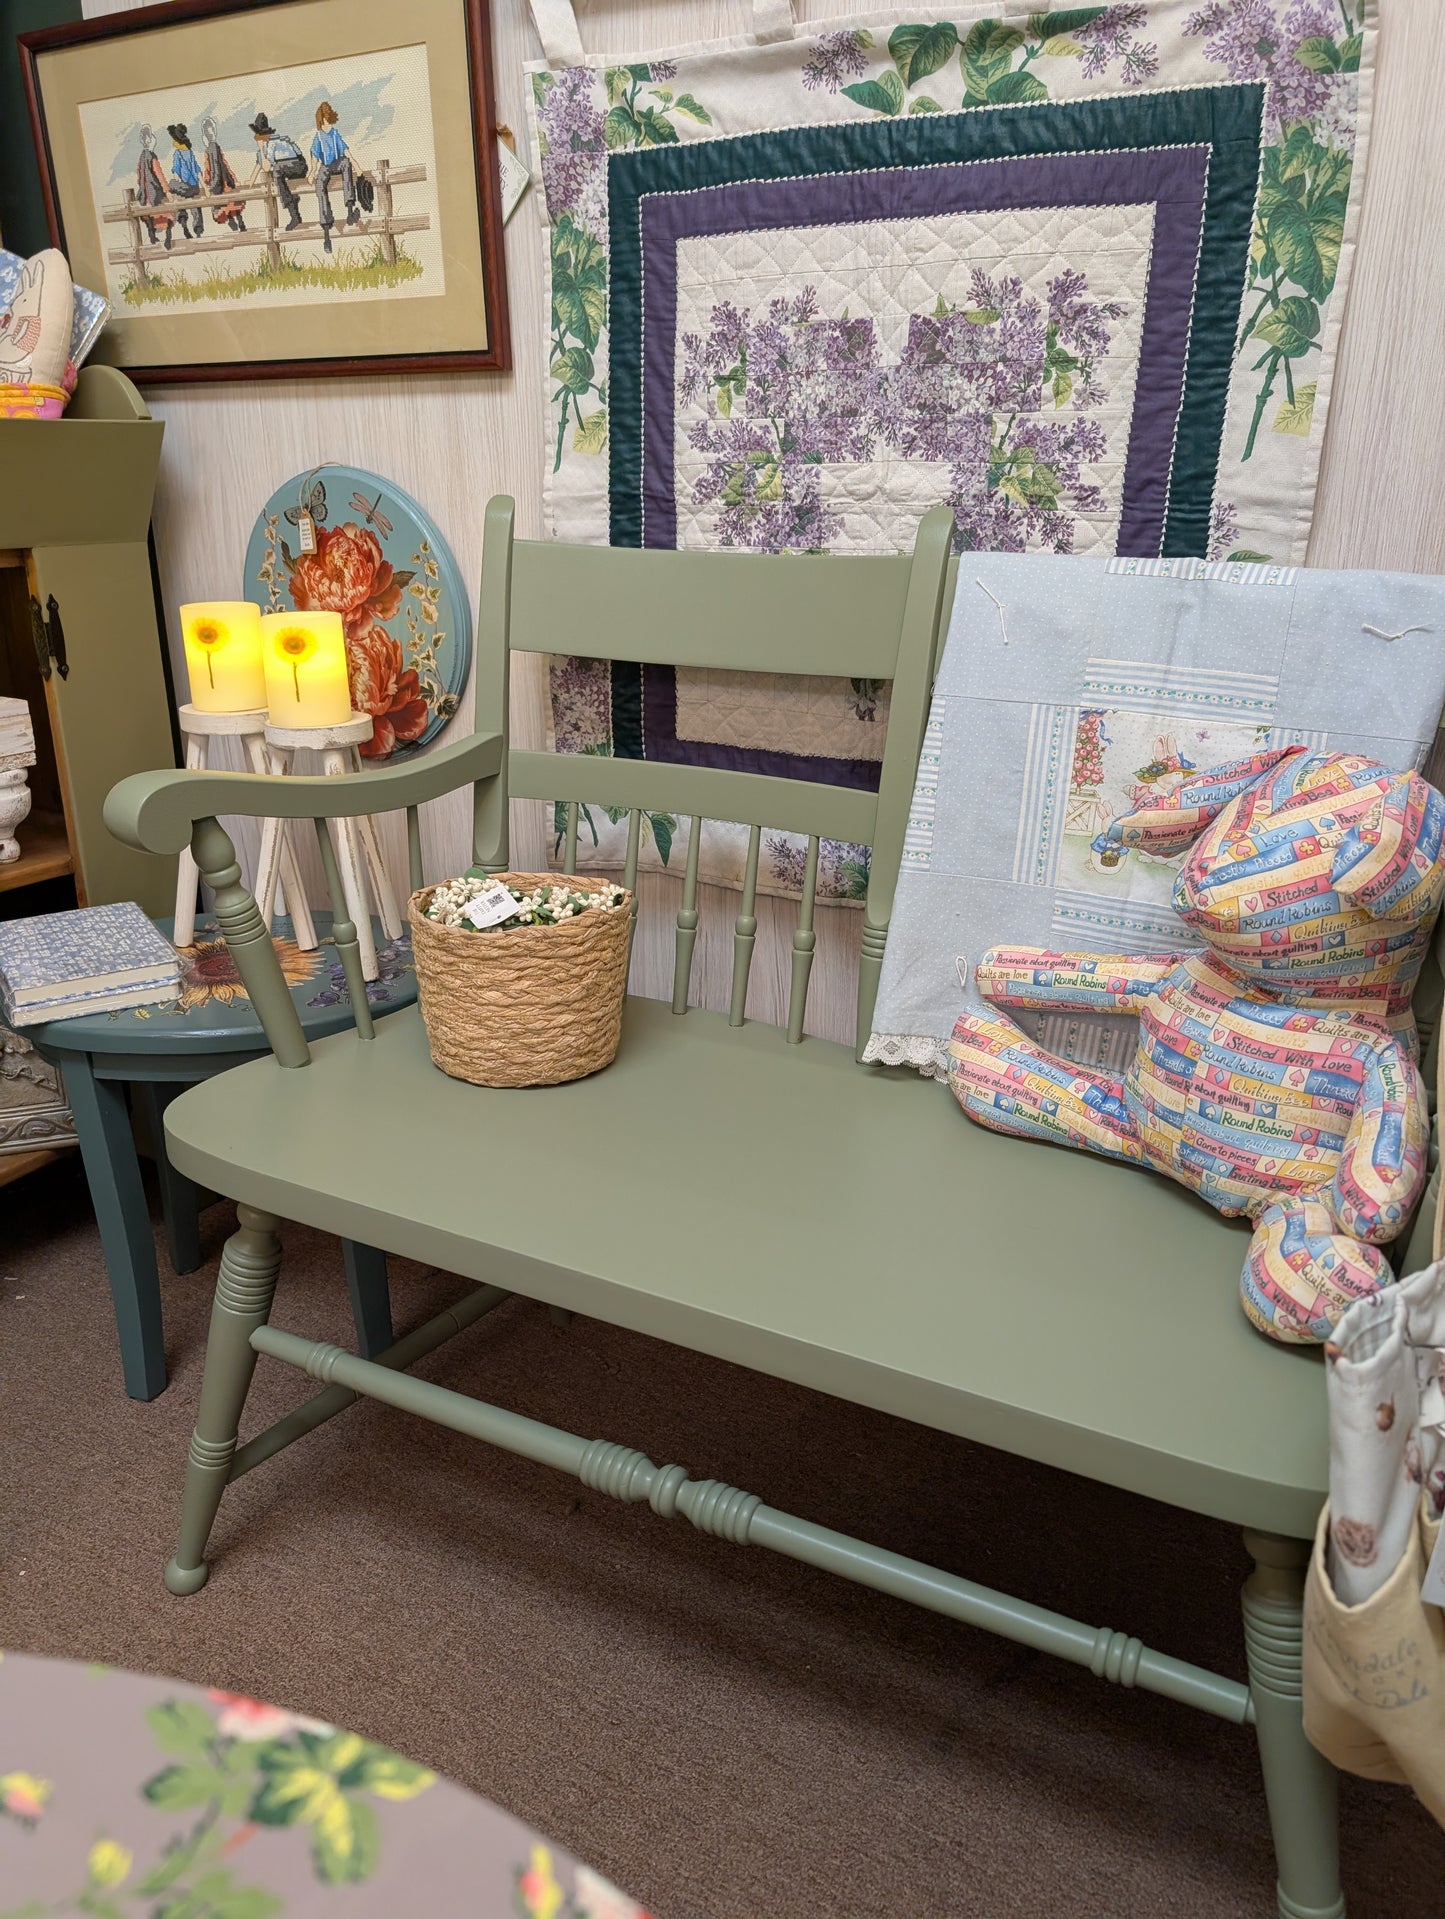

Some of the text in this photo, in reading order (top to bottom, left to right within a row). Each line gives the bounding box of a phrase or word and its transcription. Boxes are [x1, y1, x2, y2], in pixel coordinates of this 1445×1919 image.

[1205, 755, 1280, 784] Stitched Wit
[1308, 770, 1341, 789] Love
[1184, 787, 1222, 805] Round
[1260, 829, 1299, 847] Love
[1266, 879, 1318, 908] Stitched
[1242, 911, 1287, 931] Round
[1288, 900, 1333, 921] Robins
[1280, 941, 1318, 958] quilting
[1291, 946, 1365, 969] Round Robins
[996, 954, 1077, 969] Passionate about quilting
[998, 971, 1011, 980] are
[1012, 968, 1029, 980] love
[1053, 972, 1107, 990] Round Robins
[1304, 977, 1339, 988] pieces
[1357, 987, 1382, 998] Bee
[1182, 1006, 1195, 1016] are
[1196, 1007, 1212, 1022] love
[967, 1033, 985, 1048] Bee
[981, 1025, 1015, 1045] Love
[1161, 1026, 1178, 1046] Love
[1311, 1020, 1348, 1038] Quilts
[1350, 1031, 1370, 1043] are
[1202, 1042, 1277, 1081] Round Robins
[1226, 1036, 1352, 1073] Stitched With Love
[1002, 1049, 1067, 1084] Round Robins
[958, 1062, 1039, 1106] Passionate about quilting
[959, 1083, 973, 1094] are
[973, 1085, 990, 1100] love
[1099, 1079, 1114, 1094] Lov
[1194, 1083, 1251, 1112] about quilting
[1014, 1102, 1069, 1136] Round Robins
[1221, 1110, 1255, 1132] Round
[1255, 1119, 1294, 1139] Robins
[1193, 1152, 1209, 1168] joy
[1195, 1136, 1257, 1167] Gone to pieces
[1285, 1164, 1327, 1180] Love
[1269, 1177, 1294, 1192] Bee
[1346, 1184, 1366, 1210] With
[1301, 1261, 1331, 1297] Quilts
